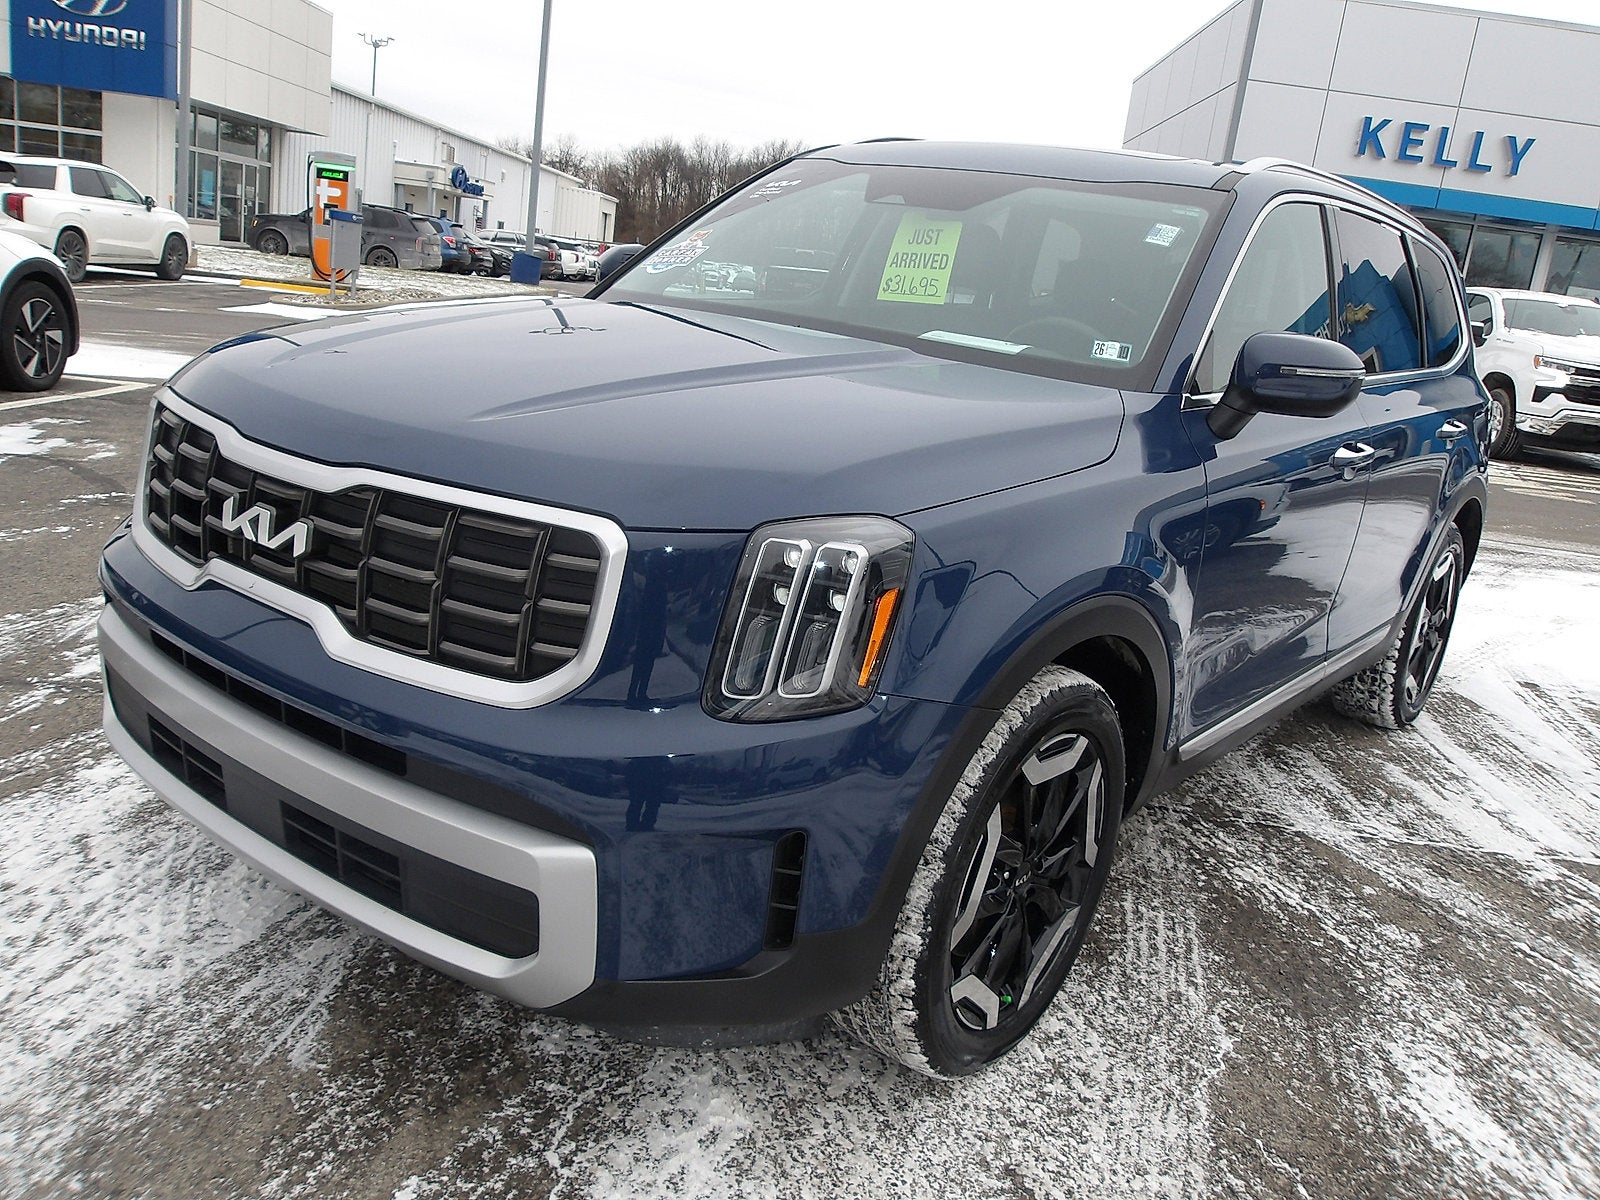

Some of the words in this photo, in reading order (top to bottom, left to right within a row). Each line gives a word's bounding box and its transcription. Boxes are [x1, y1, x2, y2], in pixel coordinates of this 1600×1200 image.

[27, 16, 146, 51] HYUNDAI
[1355, 116, 1537, 177] KELLY
[908, 228, 944, 245] JUST
[890, 252, 949, 270] ARRIVED
[882, 275, 940, 297] $31,695
[1094, 342, 1106, 356] 26
[222, 495, 308, 558] KIA
